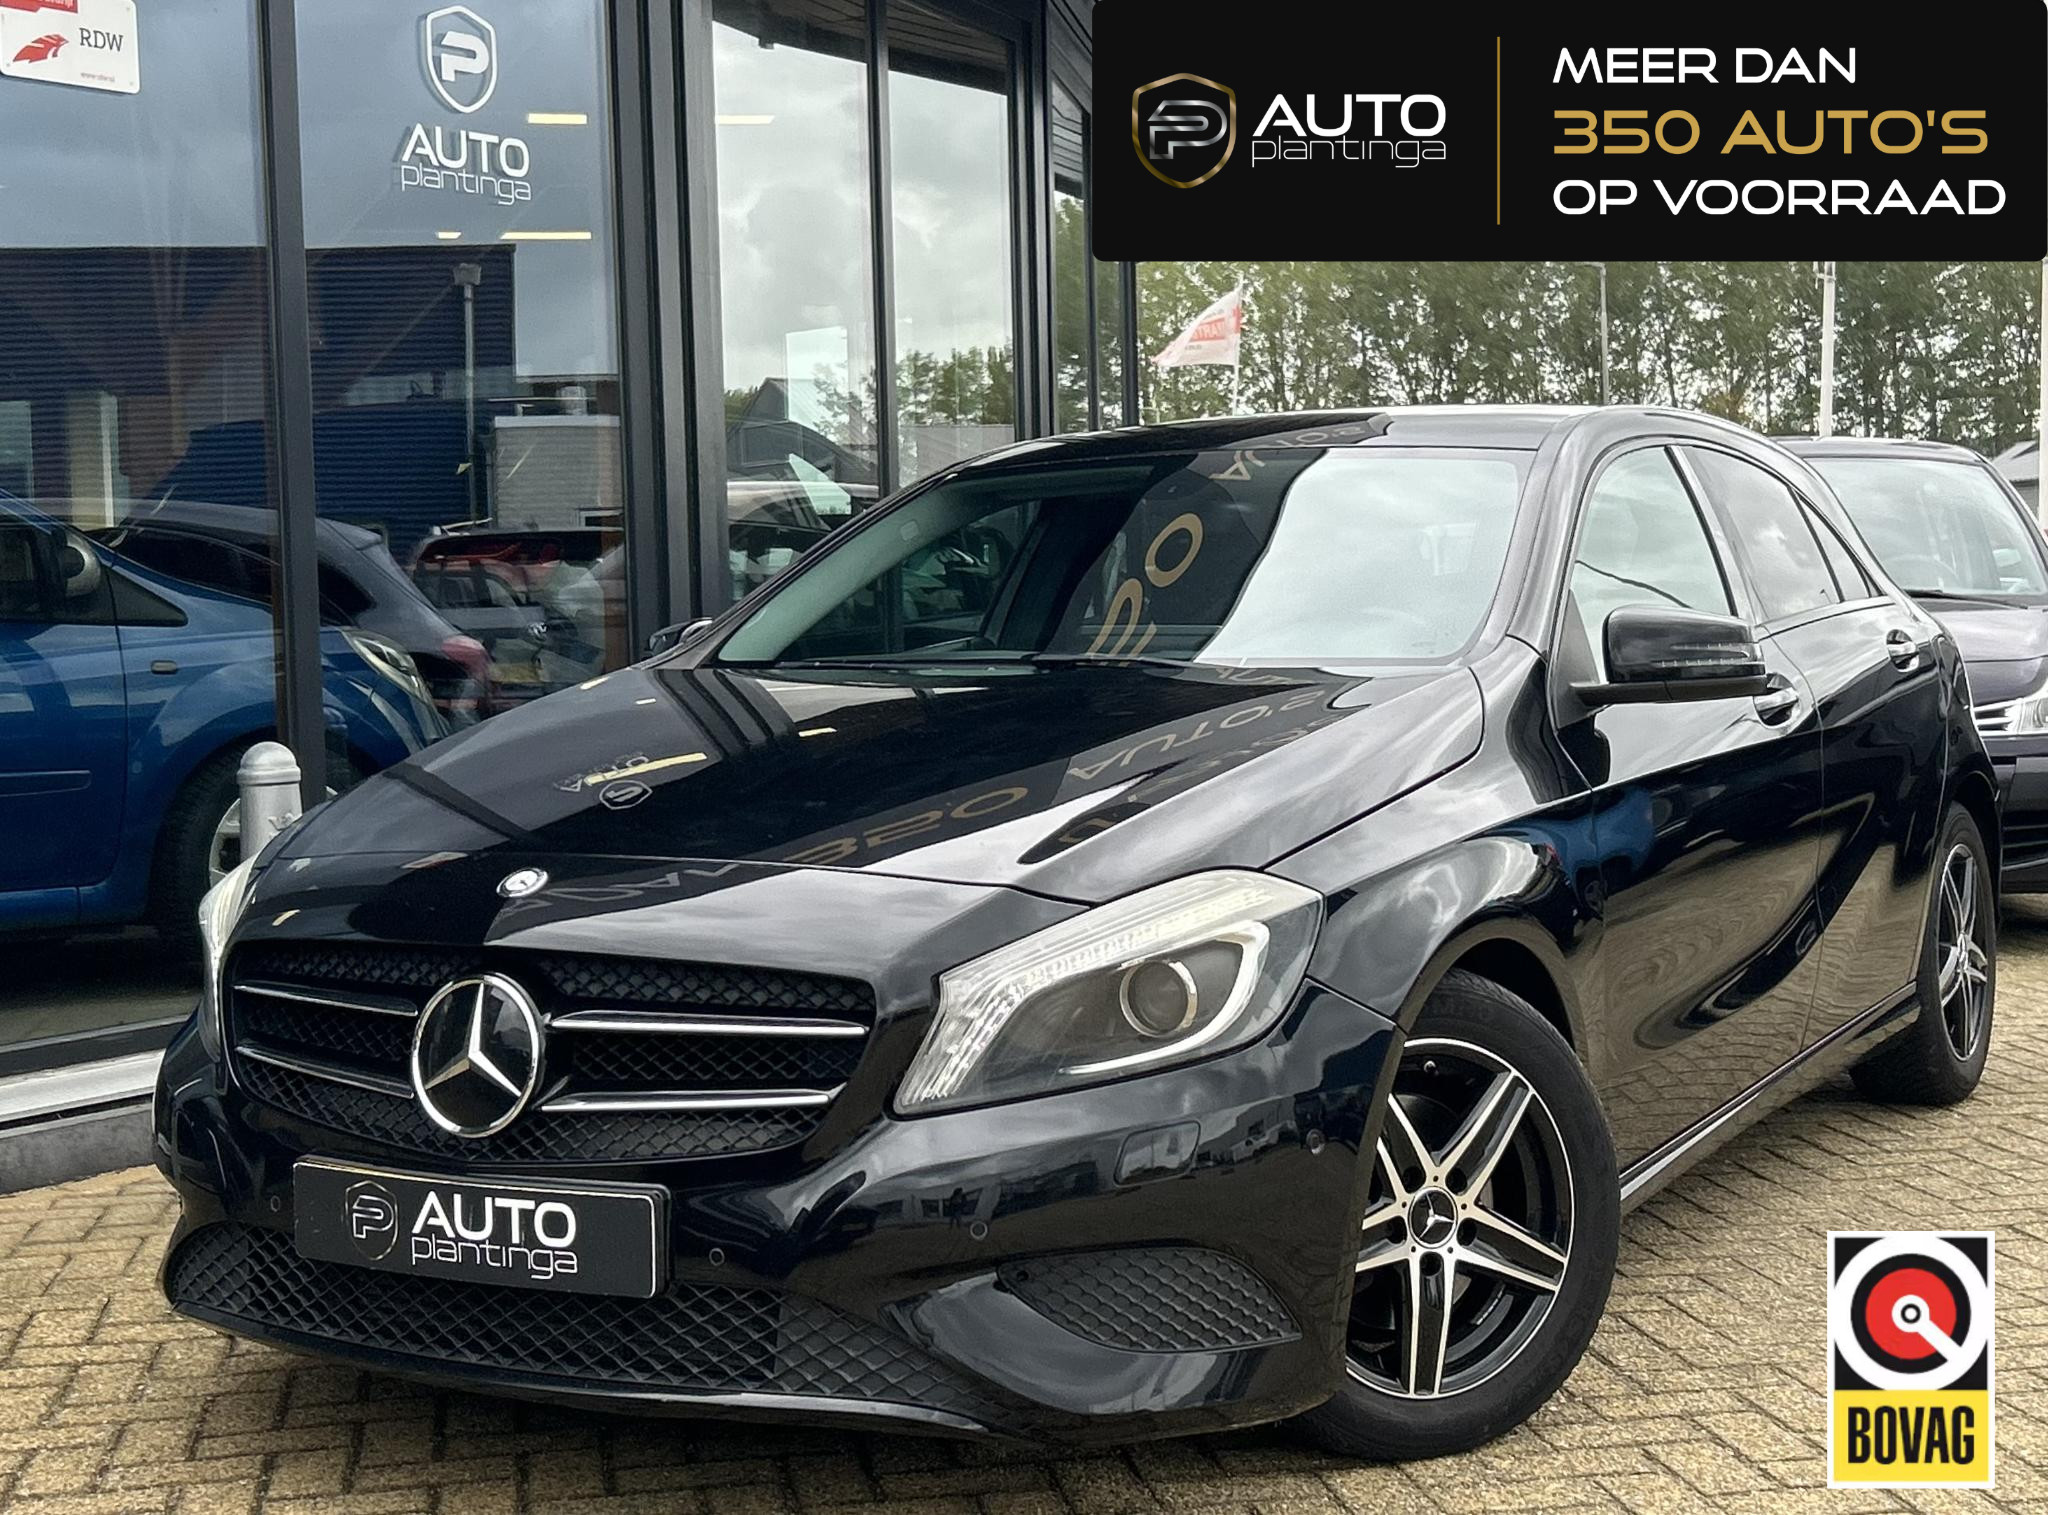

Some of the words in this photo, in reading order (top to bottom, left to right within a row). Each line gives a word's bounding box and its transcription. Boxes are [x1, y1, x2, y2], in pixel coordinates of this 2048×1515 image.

[79, 28, 124, 52] RDW
[401, 123, 529, 177] AUTO
[401, 163, 531, 206] plantinga
[412, 1191, 577, 1248] AUTO
[411, 1236, 578, 1280] plantinga
